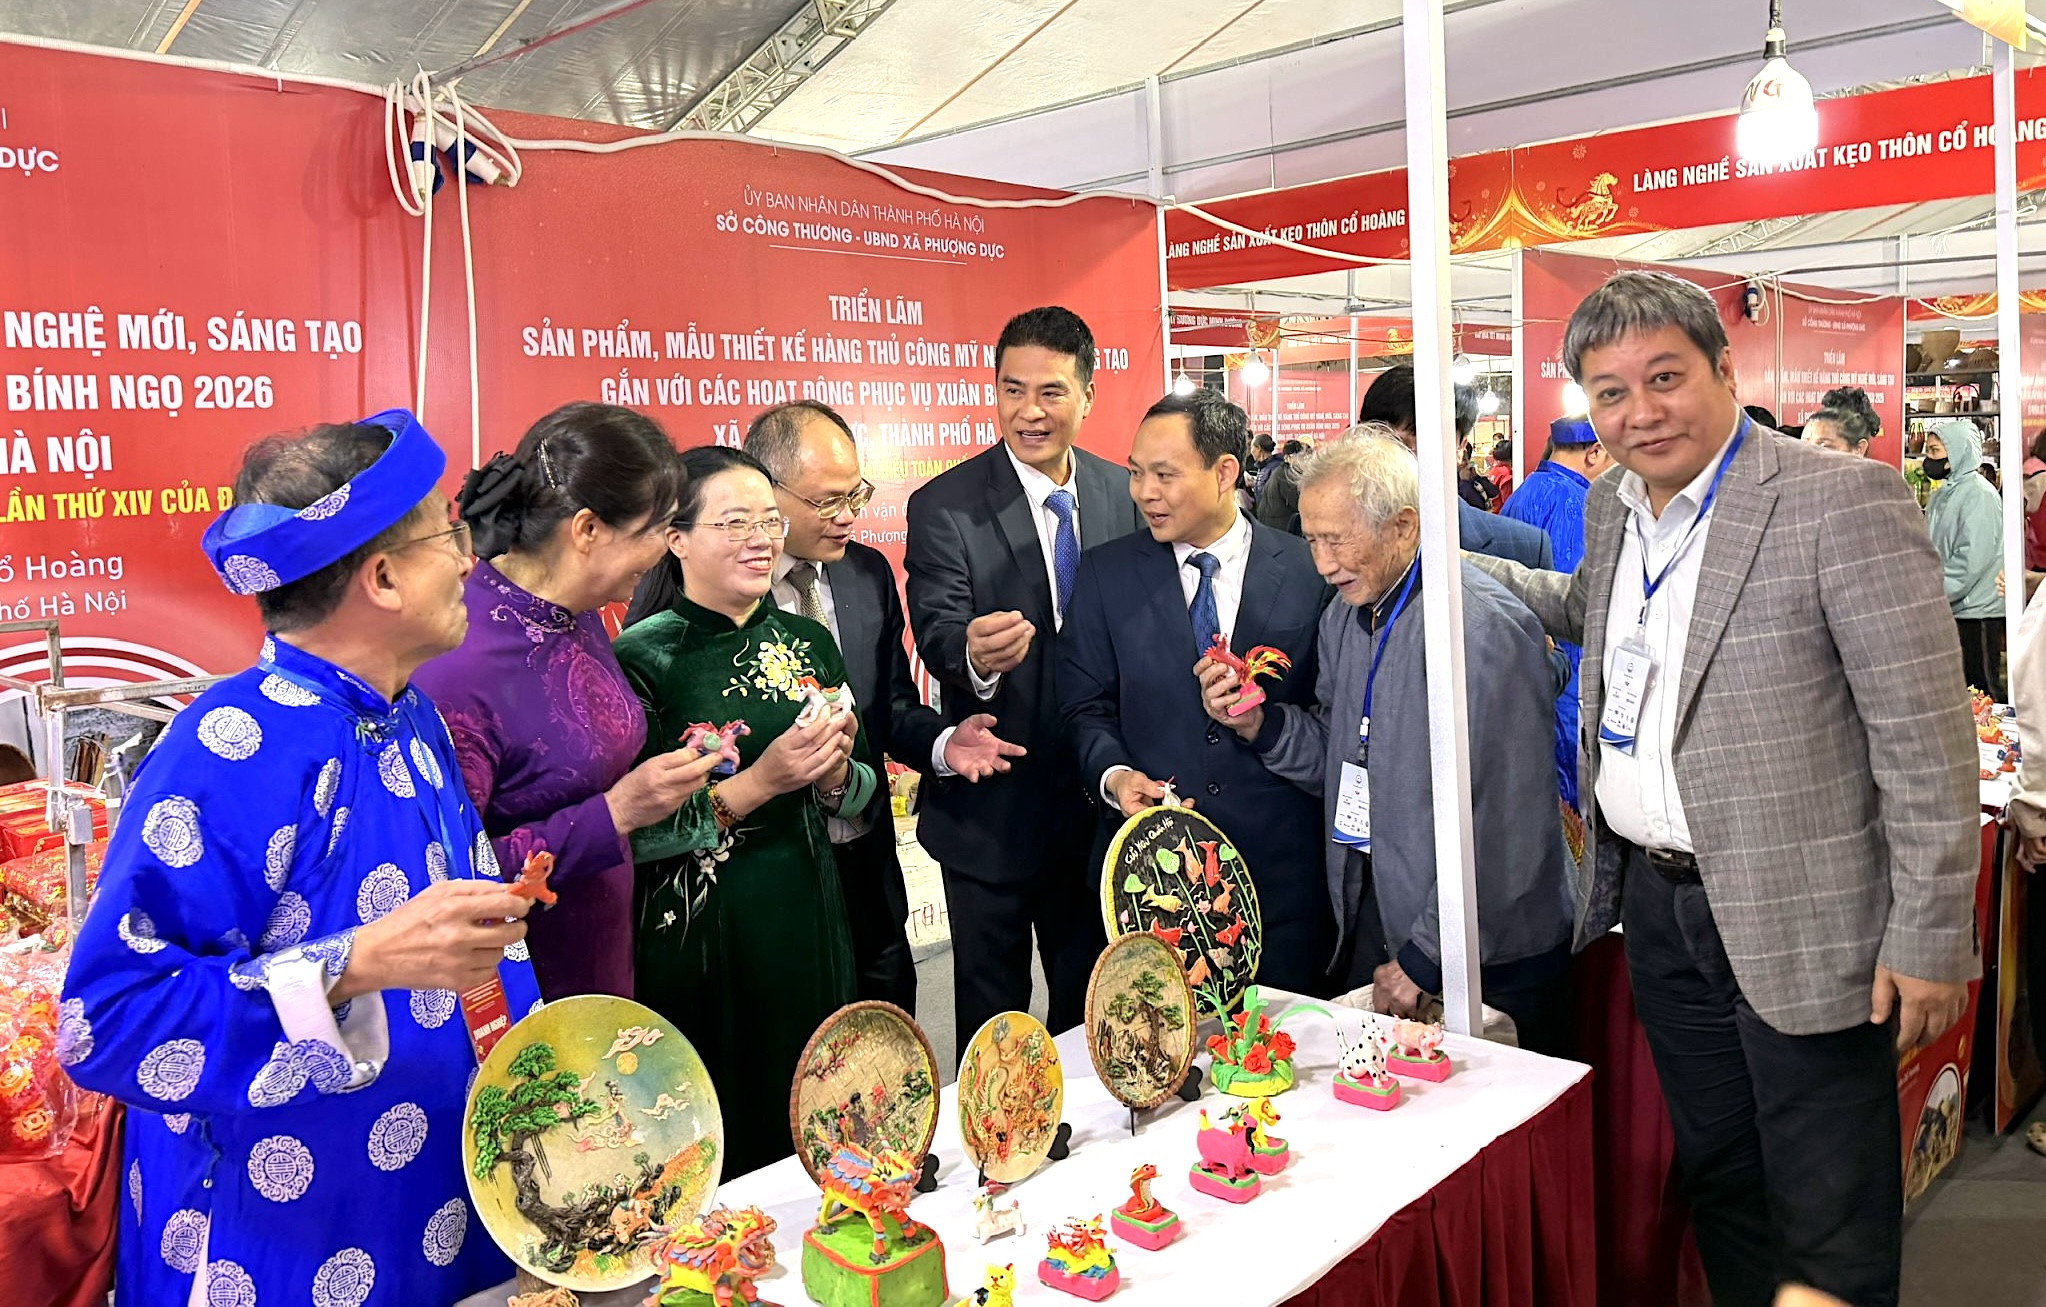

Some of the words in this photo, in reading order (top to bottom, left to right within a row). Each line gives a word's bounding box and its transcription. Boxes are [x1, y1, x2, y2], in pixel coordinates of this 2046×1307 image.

[0, 146, 59, 176] DỰC
[1634, 168, 1678, 193] LÀNG
[1683, 155, 1730, 187] NGHỀ
[1833, 141, 1872, 168] KẸO
[1878, 131, 1932, 160] THÔN
[1938, 120, 1968, 152] CỔ
[1973, 117, 2046, 148] HNG
[744, 185, 762, 207] ỦY
[766, 191, 796, 210] BAN
[799, 195, 838, 216] NHÂN
[841, 200, 870, 220] DÂN
[872, 203, 914, 226] THÀNH
[916, 208, 942, 228] PHỐ
[944, 213, 961, 232] HÀ
[964, 214, 985, 234] NỘI
[716, 209, 739, 233] SỞ
[743, 215, 790, 238] CÔNG
[793, 222, 853, 244] THƯƠNG
[863, 233, 899, 249] UBND
[902, 231, 922, 251] XÃ
[924, 238, 977, 258] PHƯỢNG
[979, 243, 1005, 261] DỰC
[1192, 232, 1221, 256] NGHỀ
[1223, 230, 1246, 250] SẢN
[1305, 218, 1339, 240] THÔN
[1341, 210, 1359, 234] CỔ
[1361, 208, 1406, 232] HOÀNG
[828, 287, 882, 324] TRIỂN
[886, 294, 923, 326] LÃM
[5, 306, 104, 358] NGHỆ
[118, 308, 197, 356] MỚI,
[207, 310, 297, 353] SÁNG
[305, 319, 363, 360] TẠO
[522, 316, 575, 357] SẢN
[582, 318, 659, 362] PHẨM,
[665, 321, 715, 360] MẪU
[720, 326, 776, 361] THIẾT
[782, 329, 807, 362] KẾ
[811, 335, 862, 364] HÀNG
[867, 332, 900, 365] THỦ
[905, 338, 950, 367] CÔNG
[955, 339, 979, 368] MỸ
[1103, 347, 1129, 375] TẠO
[7, 367, 98, 411] BÍNH
[110, 377, 183, 417] NGỌ
[194, 376, 273, 409] 2026
[601, 367, 650, 406] GẮN
[655, 372, 693, 406] VỚI
[698, 372, 741, 406] CÁC
[860, 381, 906, 412] PHỤC
[910, 383, 932, 412] VỤ
[936, 378, 980, 406] XUÂN
[712, 418, 742, 448] XÃ
[879, 418, 935, 447] THÀNH
[939, 414, 971, 446] PHỐ
[975, 418, 997, 446] HÀ
[46, 428, 113, 479] NỘI
[912, 457, 942, 477] TOÀN
[53, 486, 106, 520] THỨ
[112, 489, 152, 517] XIV
[161, 479, 210, 514] CỦA
[873, 502, 897, 521] vận
[860, 529, 908, 545] Phượng
[0, 554, 15, 583] ổ
[25, 551, 123, 580] Hoàng
[0, 596, 31, 621] hố
[40, 592, 75, 618] Hà
[85, 590, 127, 616] Nội
